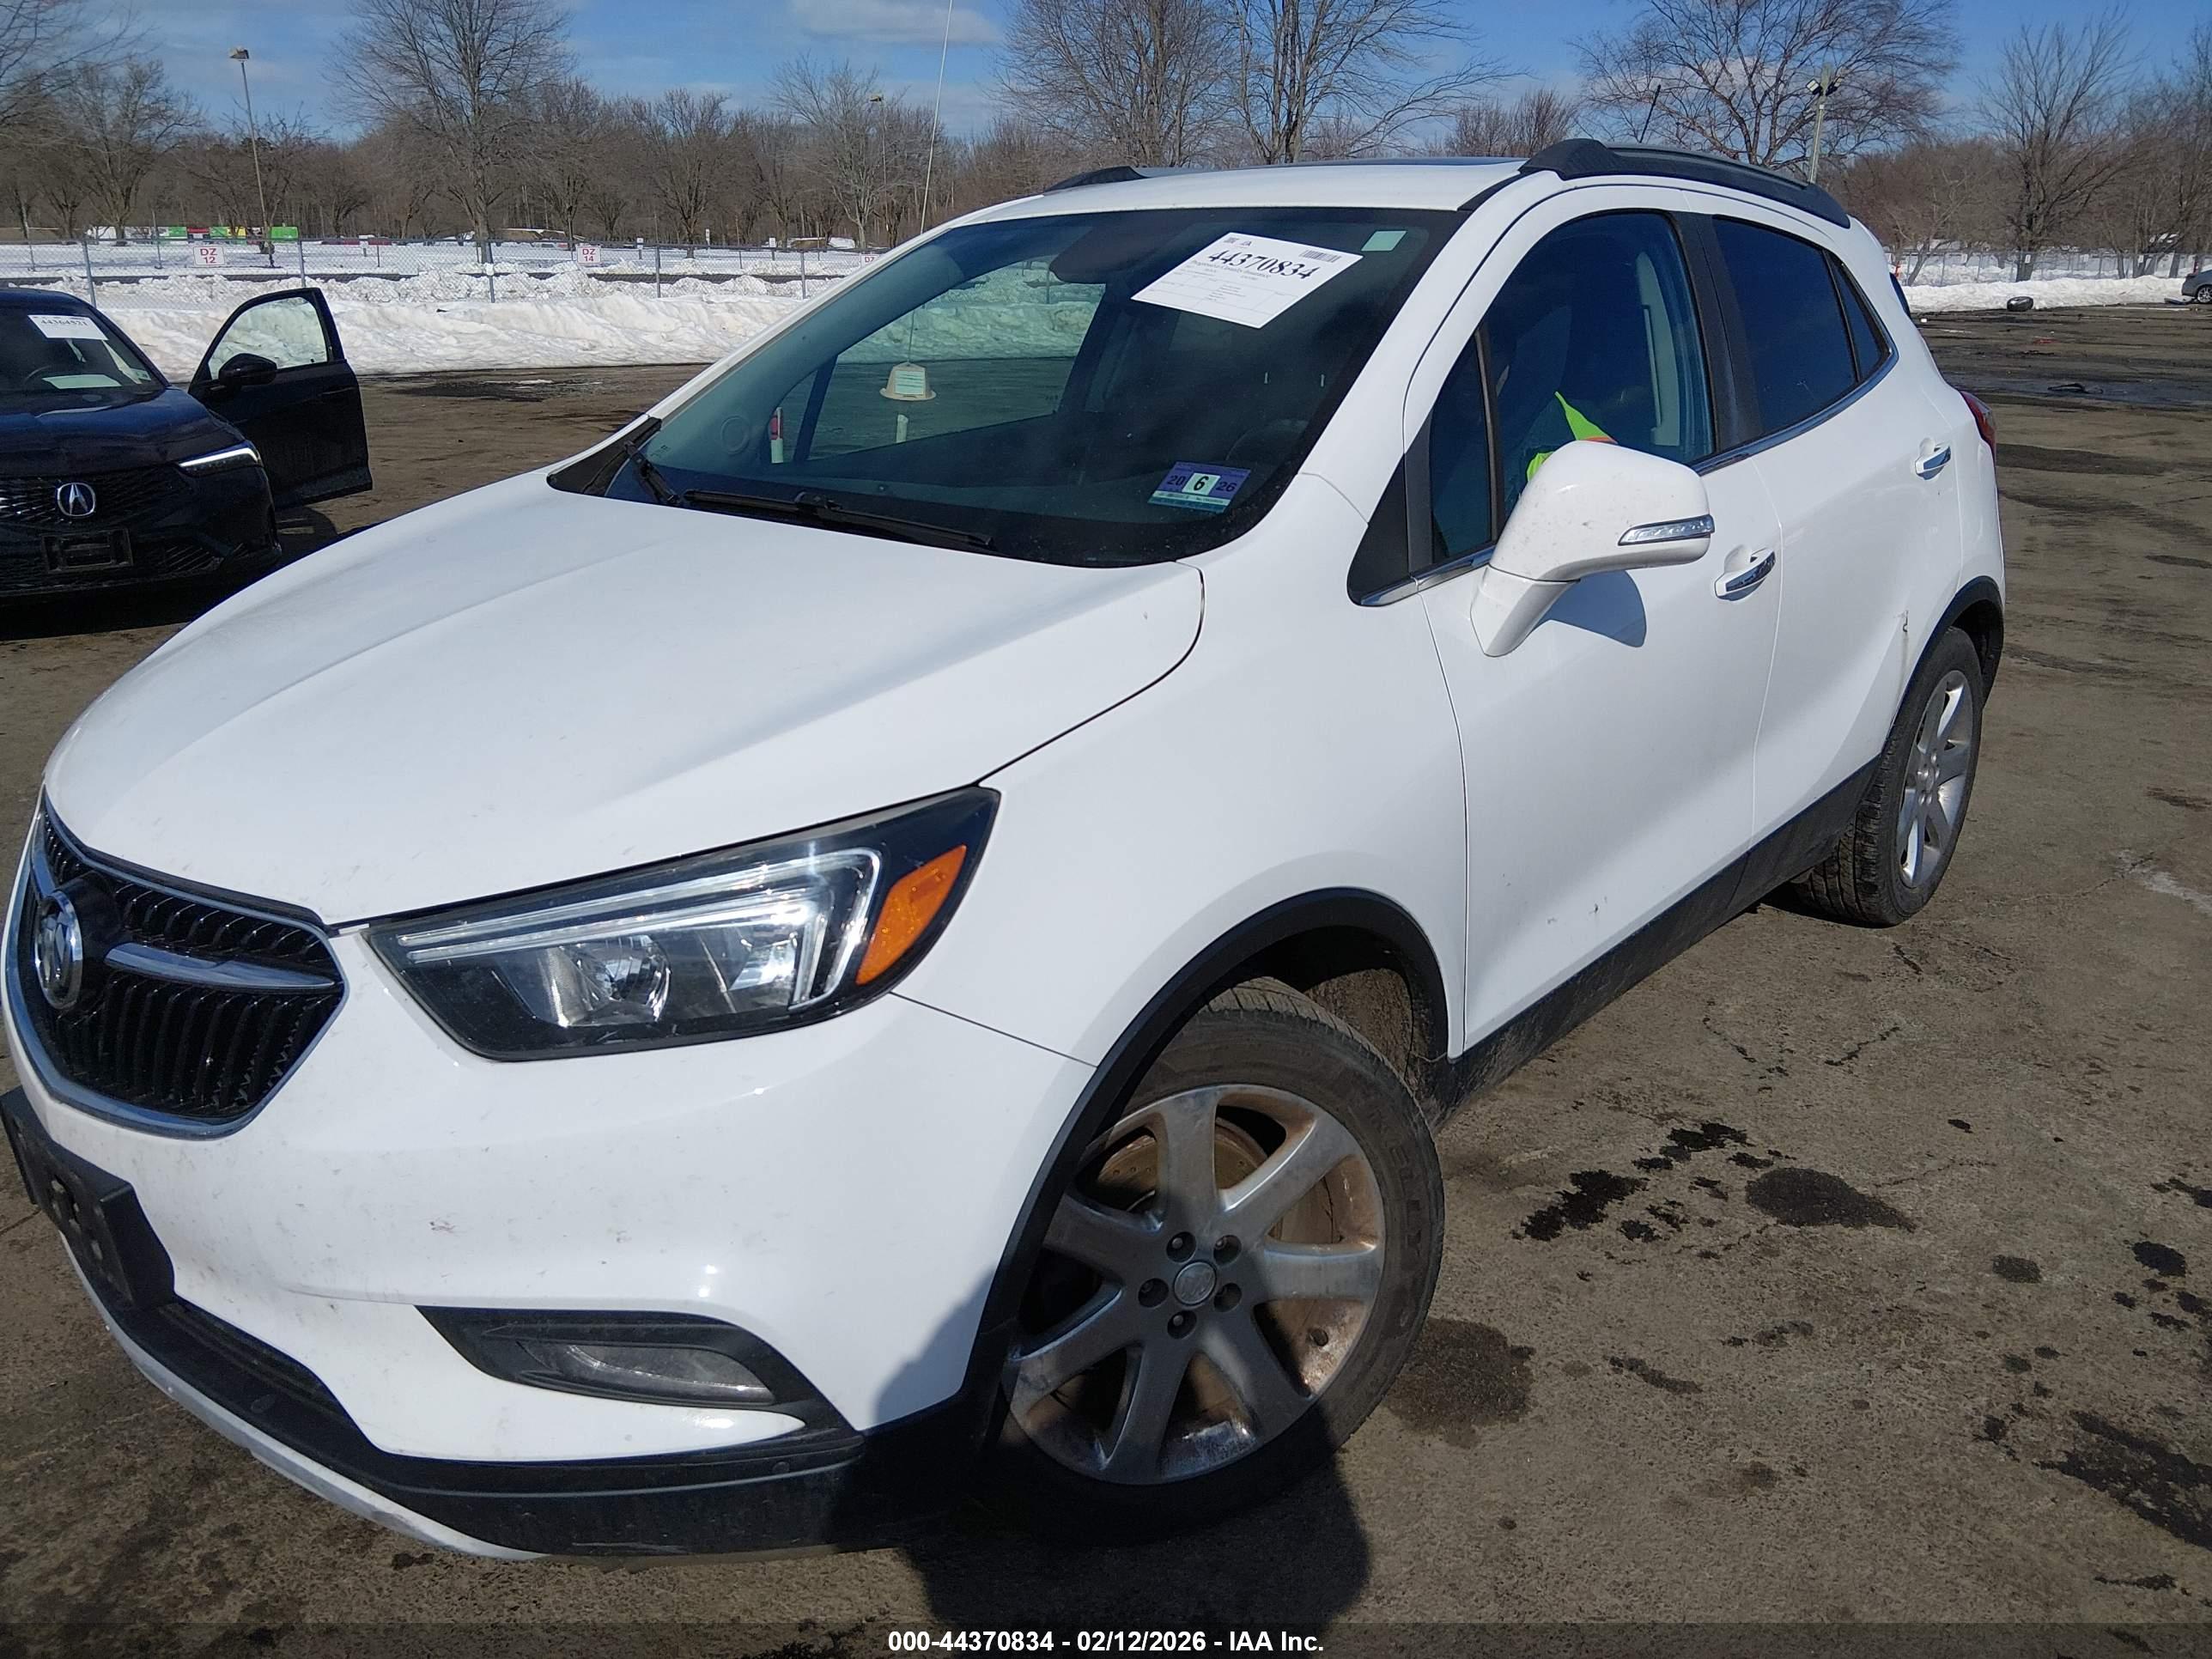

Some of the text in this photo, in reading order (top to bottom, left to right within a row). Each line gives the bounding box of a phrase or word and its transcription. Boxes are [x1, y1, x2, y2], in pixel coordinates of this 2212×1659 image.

[1208, 250, 1322, 280] 44370834
[1166, 475, 1237, 492] 20 6 26
